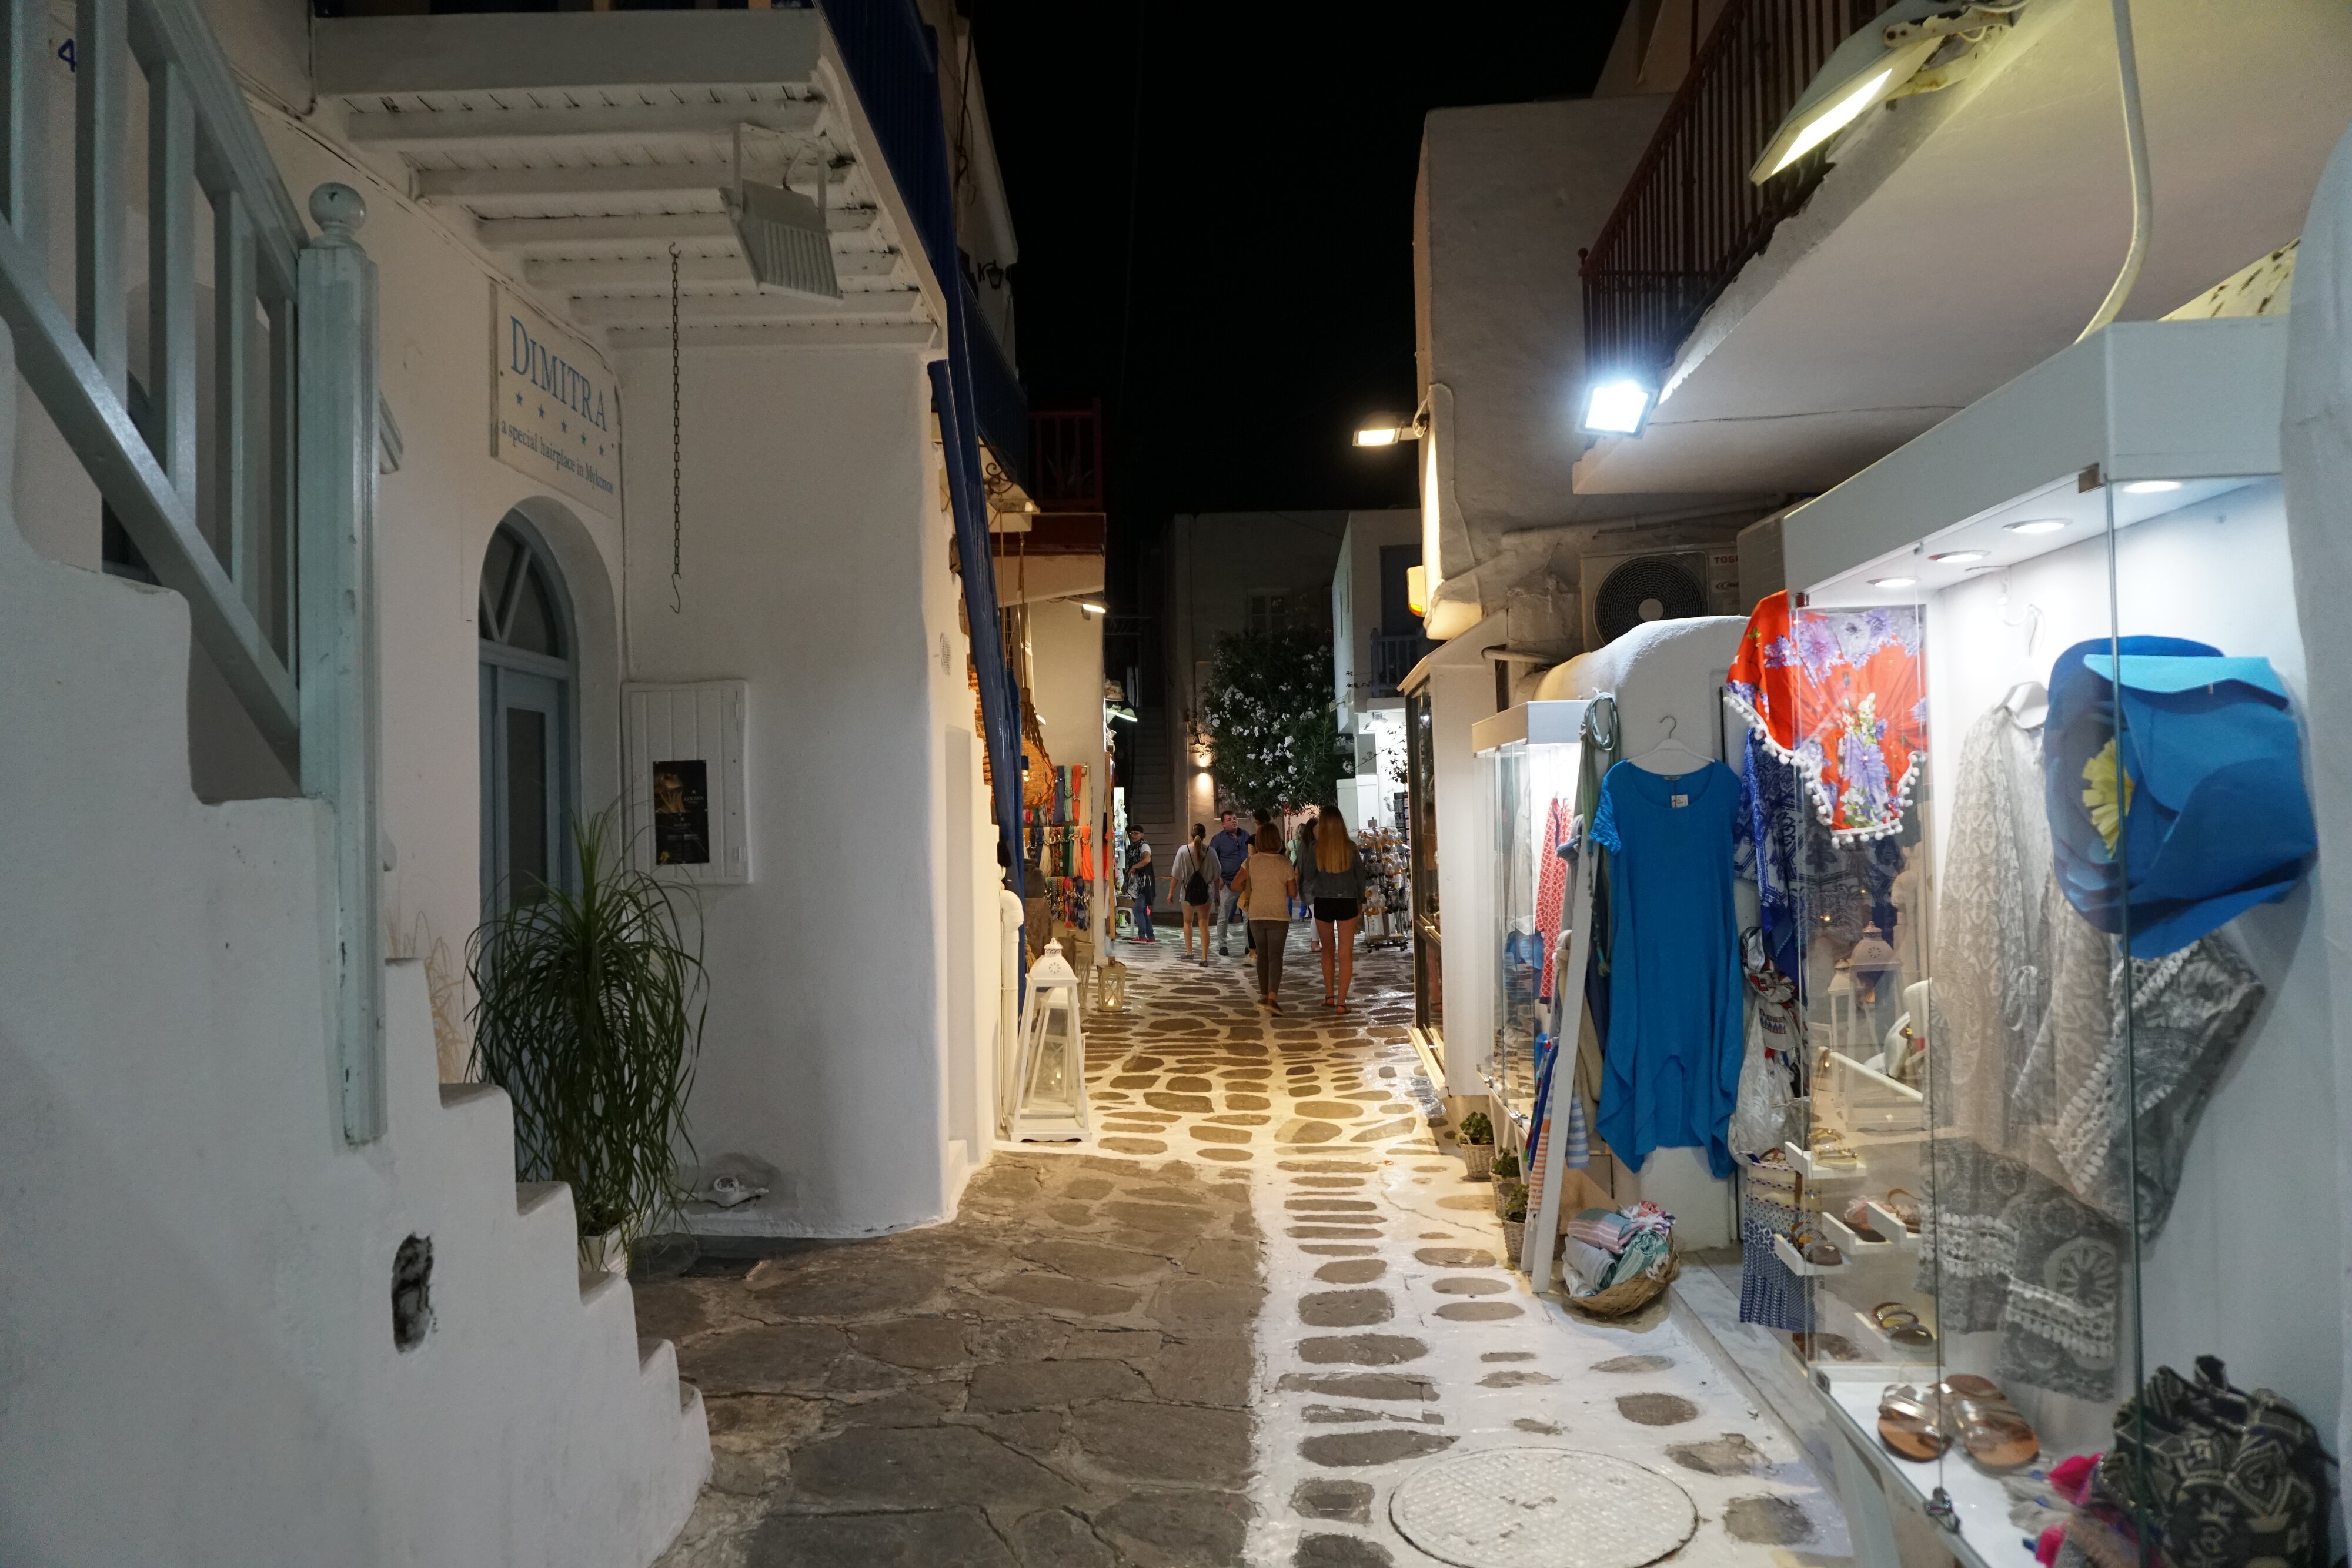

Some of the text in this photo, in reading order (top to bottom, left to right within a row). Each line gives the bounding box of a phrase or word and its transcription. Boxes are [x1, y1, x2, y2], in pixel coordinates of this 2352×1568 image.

[58, 38, 76, 73] 4
[510, 315, 607, 432] DIMITRA
[501, 420, 613, 494] a special hairplace in Mykonos
